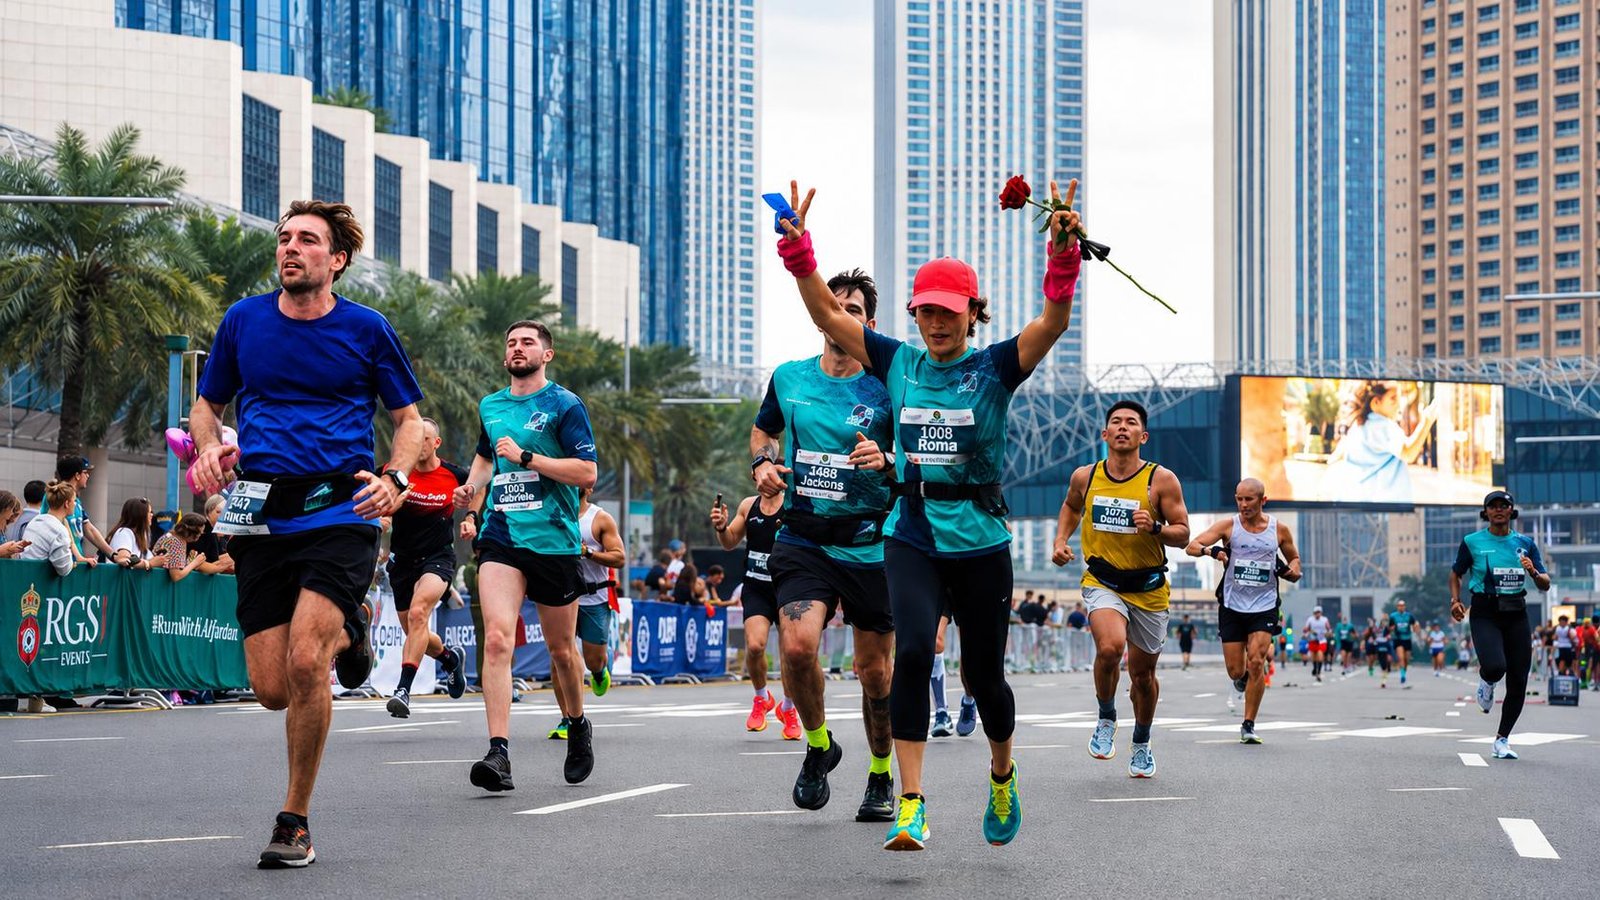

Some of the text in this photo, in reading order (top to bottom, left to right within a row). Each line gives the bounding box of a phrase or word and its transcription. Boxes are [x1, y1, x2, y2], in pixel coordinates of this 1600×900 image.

[920, 426, 953, 440] 1008
[918, 438, 958, 452] Roma
[43, 594, 101, 645] RGS
[60, 650, 91, 667] EVENTS
